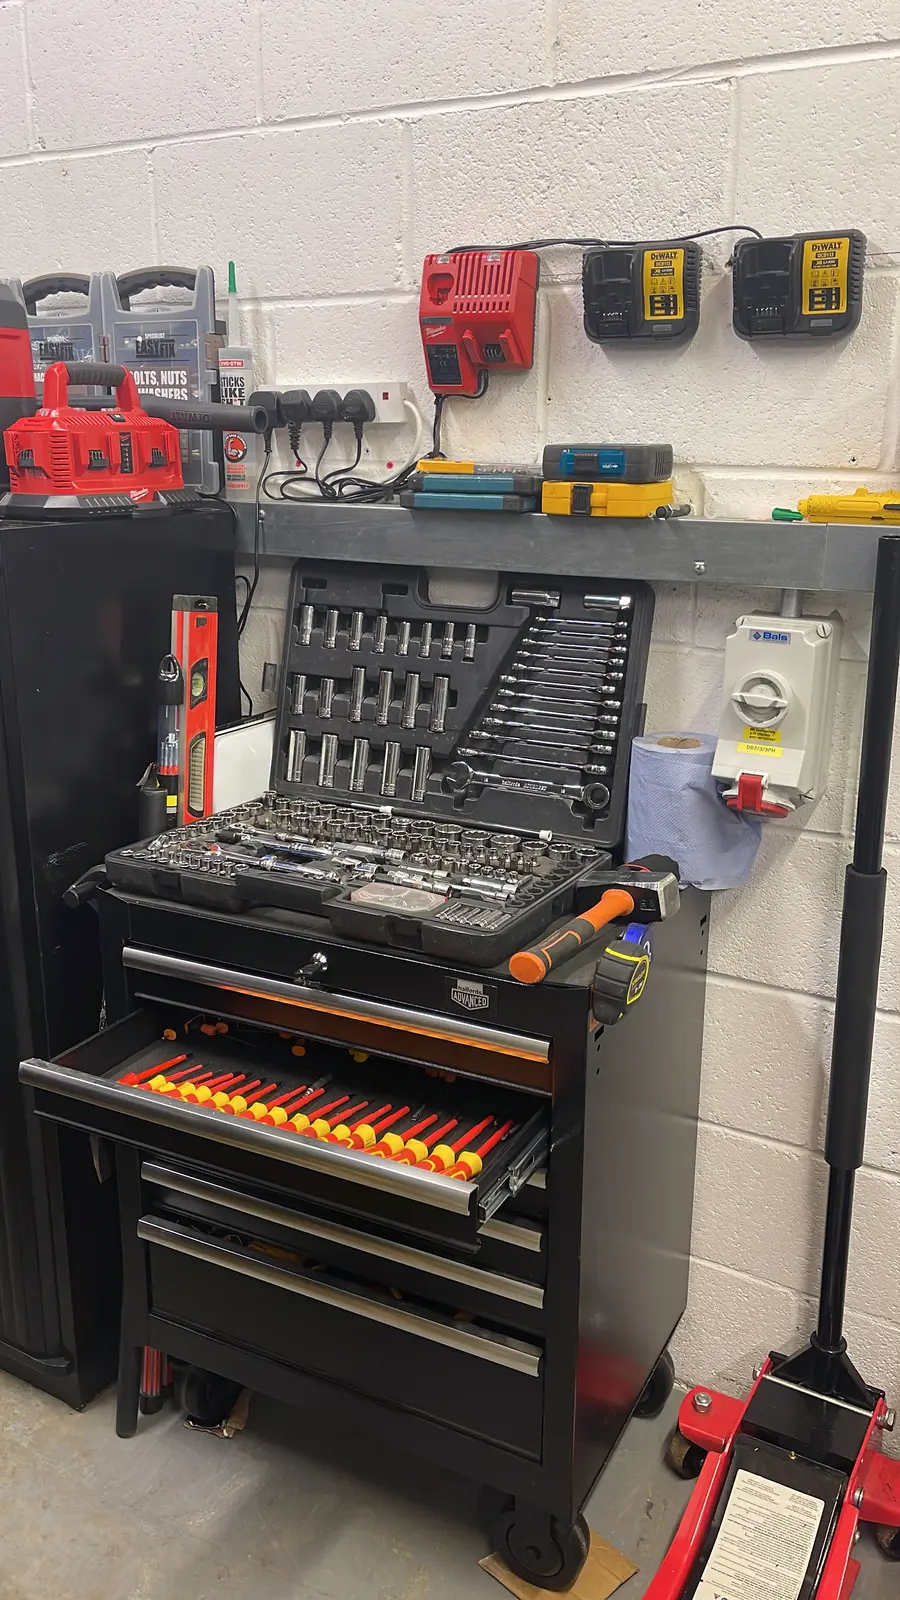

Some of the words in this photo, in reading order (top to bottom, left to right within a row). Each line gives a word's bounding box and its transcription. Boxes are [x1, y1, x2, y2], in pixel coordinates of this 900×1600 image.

[129, 370, 160, 386] OLTS,
[160, 370, 187, 385] NUTS
[221, 387, 245, 398] LIKE
[763, 631, 788, 641] Bals
[453, 991, 487, 1008] ADVANCED
